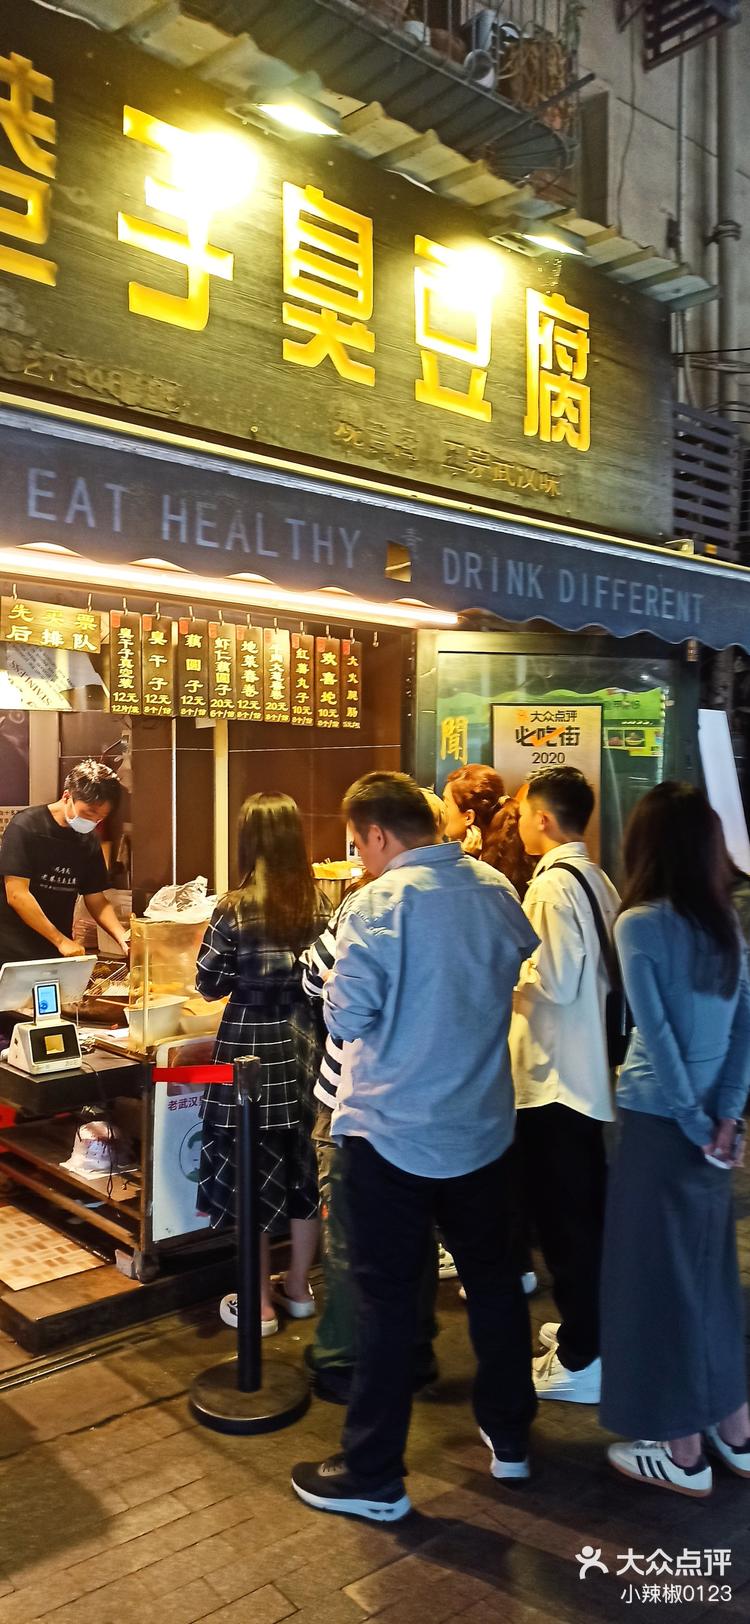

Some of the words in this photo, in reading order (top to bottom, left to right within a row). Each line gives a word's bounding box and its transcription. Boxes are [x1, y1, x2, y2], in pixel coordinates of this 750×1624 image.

[26, 467, 127, 533] EAT
[161, 494, 361, 569] HEALTHY
[442, 547, 544, 599] DRINK
[559, 568, 704, 625] DIFFERENT
[8, 604, 98, 630] 先买票
[6, 625, 97, 651] 后排队
[148, 630, 168, 691] 臭干子
[295, 647, 310, 703] 红薯丸子
[112, 692, 139, 703] 12元
[144, 694, 172, 705] 12元
[180, 695, 207, 706] 12元
[210, 699, 235, 708] 20元
[237, 699, 262, 709] 12元
[265, 702, 289, 711] 20元
[291, 706, 313, 715] 10元
[317, 709, 339, 718] 10元
[530, 709, 578, 723] 大众点评
[515, 725, 581, 747] 必吃街
[531, 752, 566, 764] 2020
